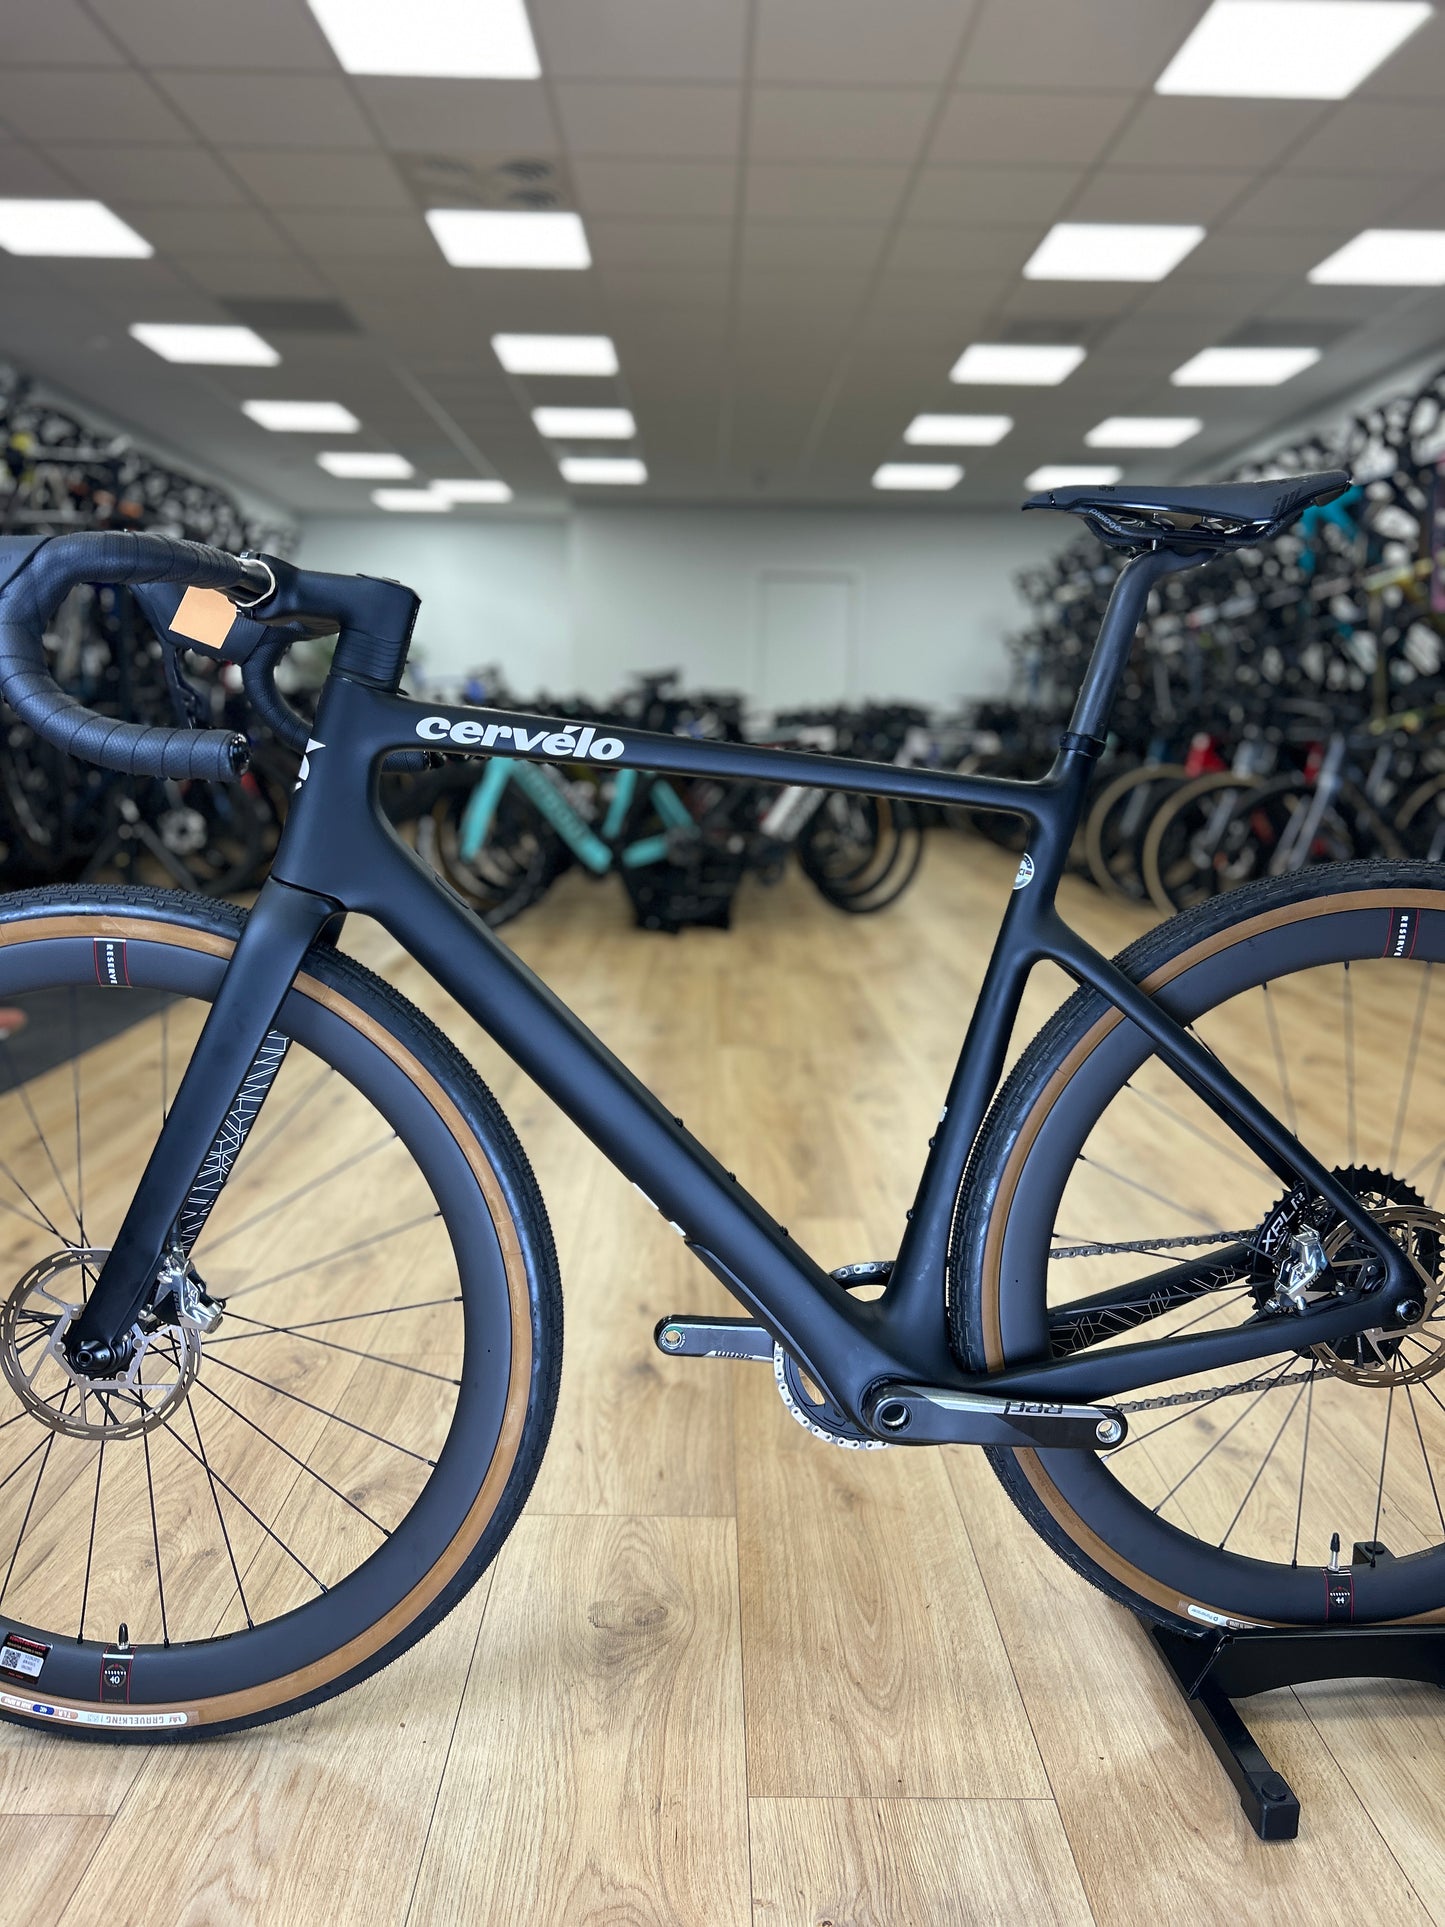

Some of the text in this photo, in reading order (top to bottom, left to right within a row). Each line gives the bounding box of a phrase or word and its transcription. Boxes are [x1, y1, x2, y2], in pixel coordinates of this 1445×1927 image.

[415, 716, 625, 761] cervélo
[105, 943, 118, 984] RESERVE
[109, 1675, 120, 1684] 40
